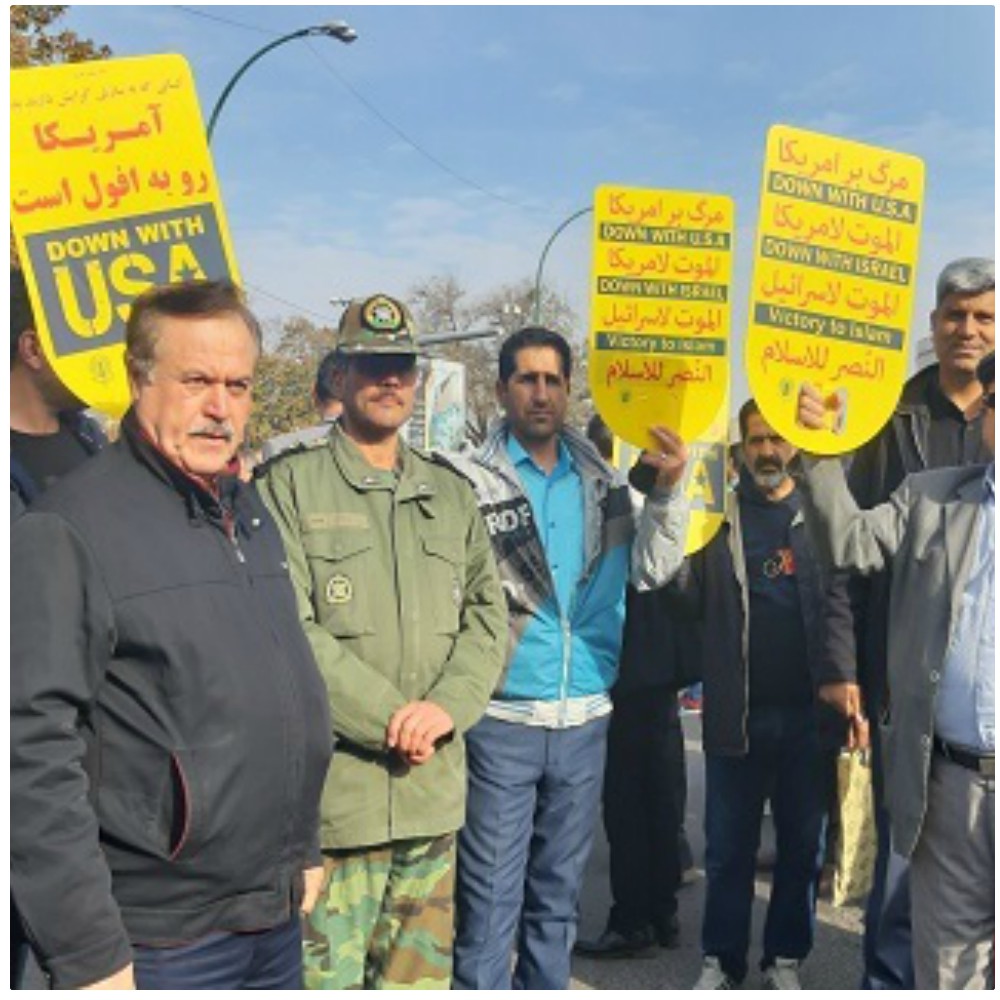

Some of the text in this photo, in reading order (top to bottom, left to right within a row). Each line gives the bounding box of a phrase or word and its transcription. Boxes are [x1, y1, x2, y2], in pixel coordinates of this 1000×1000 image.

[33, 103, 164, 154] آمریکا
[12, 164, 210, 215] رو به افول است
[868, 160, 909, 194] مرگ
[688, 199, 725, 227] مرگ
[771, 172, 914, 220] DOWN WITH U.S.A
[46, 213, 206, 263] DOWN WITH
[602, 224, 648, 242] DOWN
[650, 227, 688, 245] WITH
[763, 237, 908, 284] DOWN WITH ISRAEL
[600, 277, 725, 301] DOWN WITH ISRAEL
[768, 306, 826, 335] Victory
[829, 317, 846, 335] to
[606, 332, 657, 353] Victory
[660, 337, 675, 351] to
